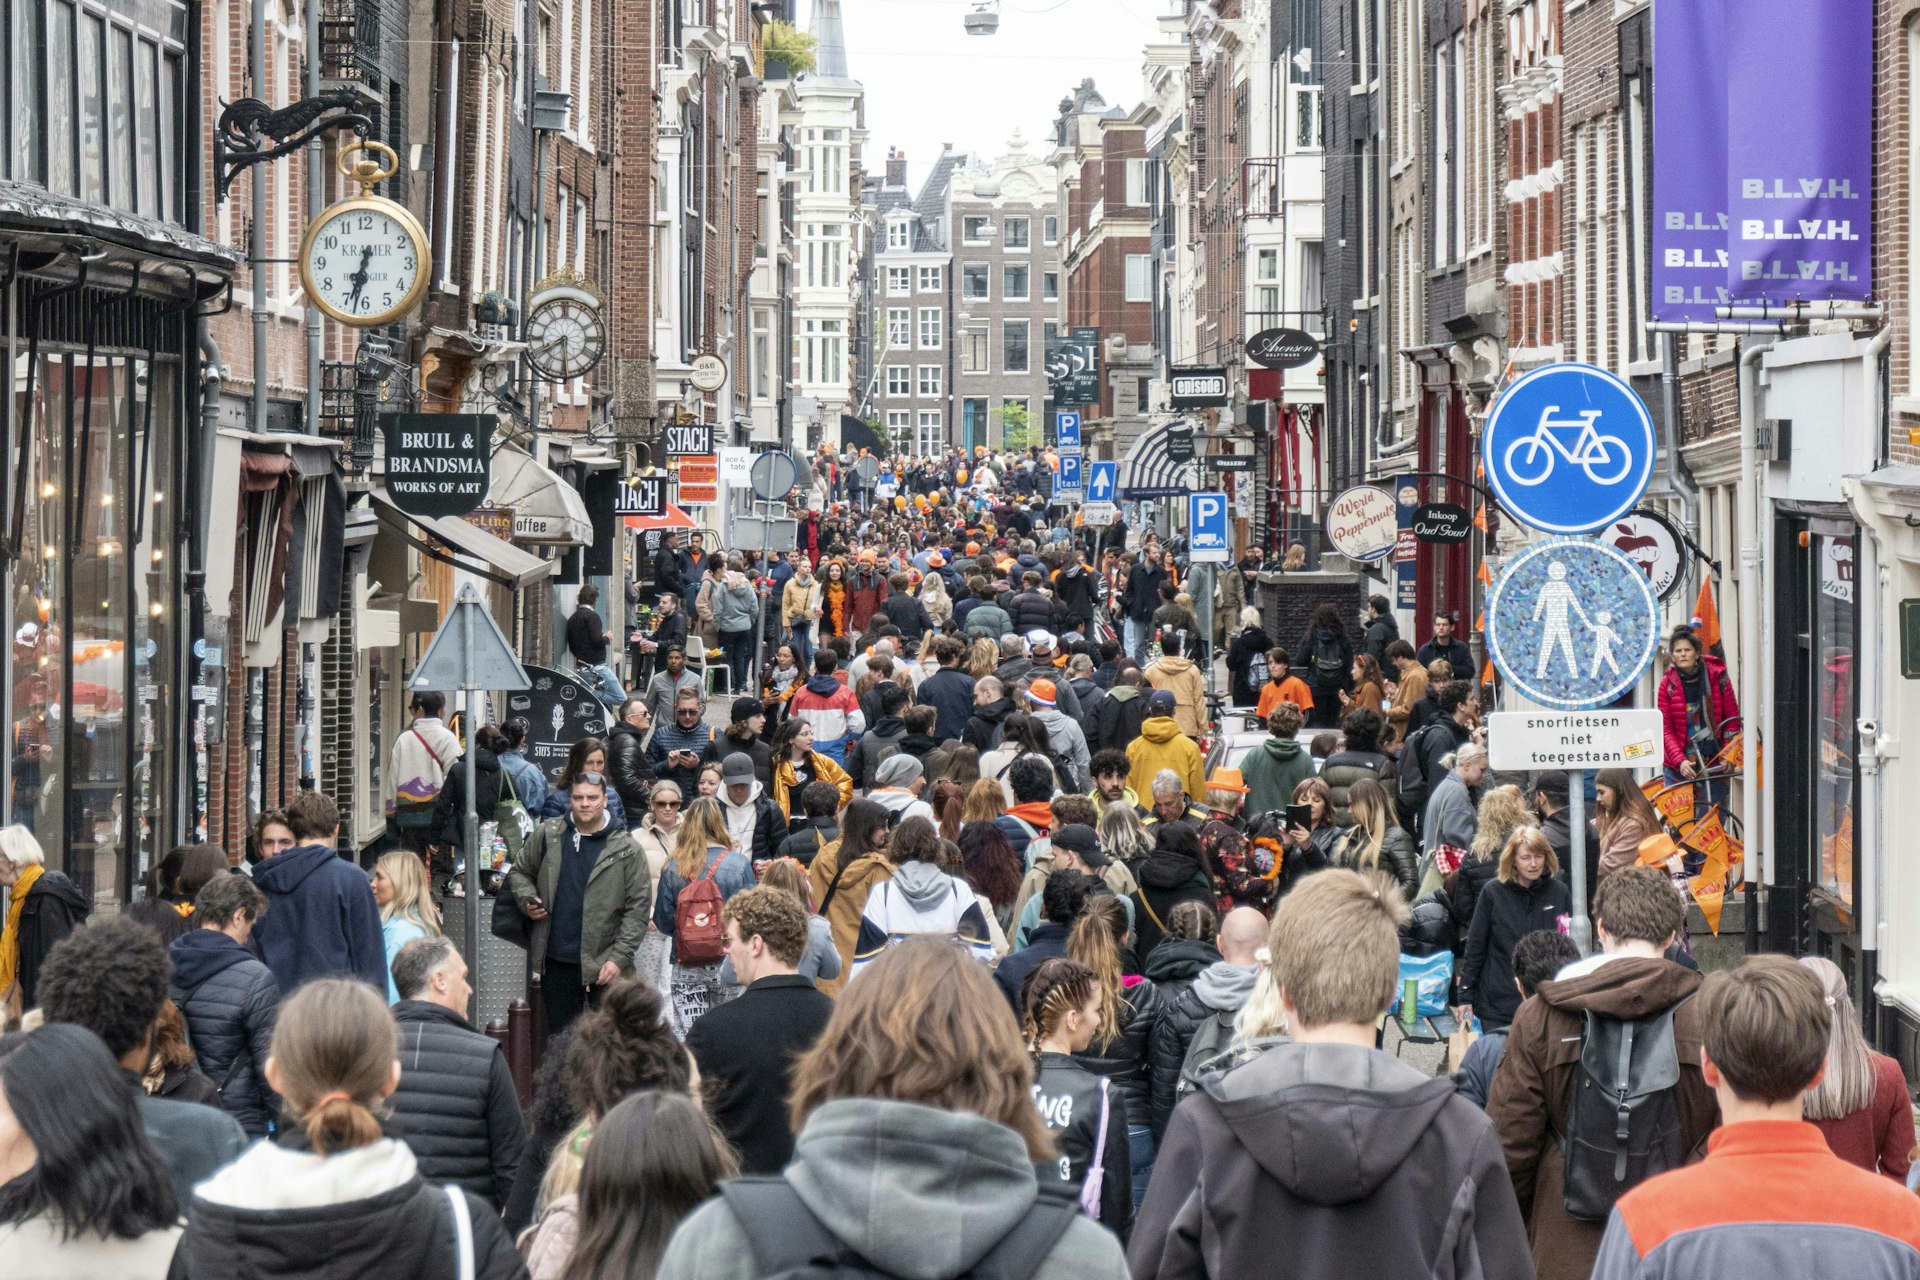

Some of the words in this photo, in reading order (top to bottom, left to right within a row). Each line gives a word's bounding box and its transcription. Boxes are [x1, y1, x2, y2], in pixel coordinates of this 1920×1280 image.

[340, 221, 351, 235] 11
[358, 215, 373, 230] 12
[383, 221, 388, 235] 1
[324, 235, 338, 250] 10
[397, 235, 406, 249] 2
[317, 256, 326, 270] 9
[404, 257, 413, 270] 3
[323, 277, 333, 291] 8
[396, 277, 405, 291] 4
[341, 292, 350, 306] 7
[361, 296, 370, 310] 6
[382, 292, 392, 306] 5
[1252, 334, 1313, 356] Aronson
[699, 362, 715, 370] B&B
[1177, 378, 1221, 395] episode
[1062, 416, 1075, 433] P
[402, 432, 455, 449] BRUIL
[462, 433, 474, 449] &
[666, 427, 709, 451] STACH
[390, 457, 485, 473] BRANDSMA
[1064, 458, 1077, 476] P
[394, 482, 436, 493] WORKS
[438, 482, 454, 494] OF
[457, 482, 481, 494] ART
[1062, 480, 1080, 488] taxi
[615, 480, 659, 509] TACH
[1336, 491, 1375, 518] World
[1198, 498, 1220, 528] P
[1356, 508, 1366, 519] of
[1428, 510, 1458, 522] Inkoop
[516, 518, 547, 533] offee
[1334, 504, 1396, 542] Peppernuts
[1414, 522, 1440, 535] Oud
[1440, 524, 1470, 538] Goud
[1527, 716, 1620, 729] snorfietsen
[1560, 733, 1592, 745] niet
[534, 746, 551, 757] STEFS
[1531, 752, 1621, 765] toegestaan
